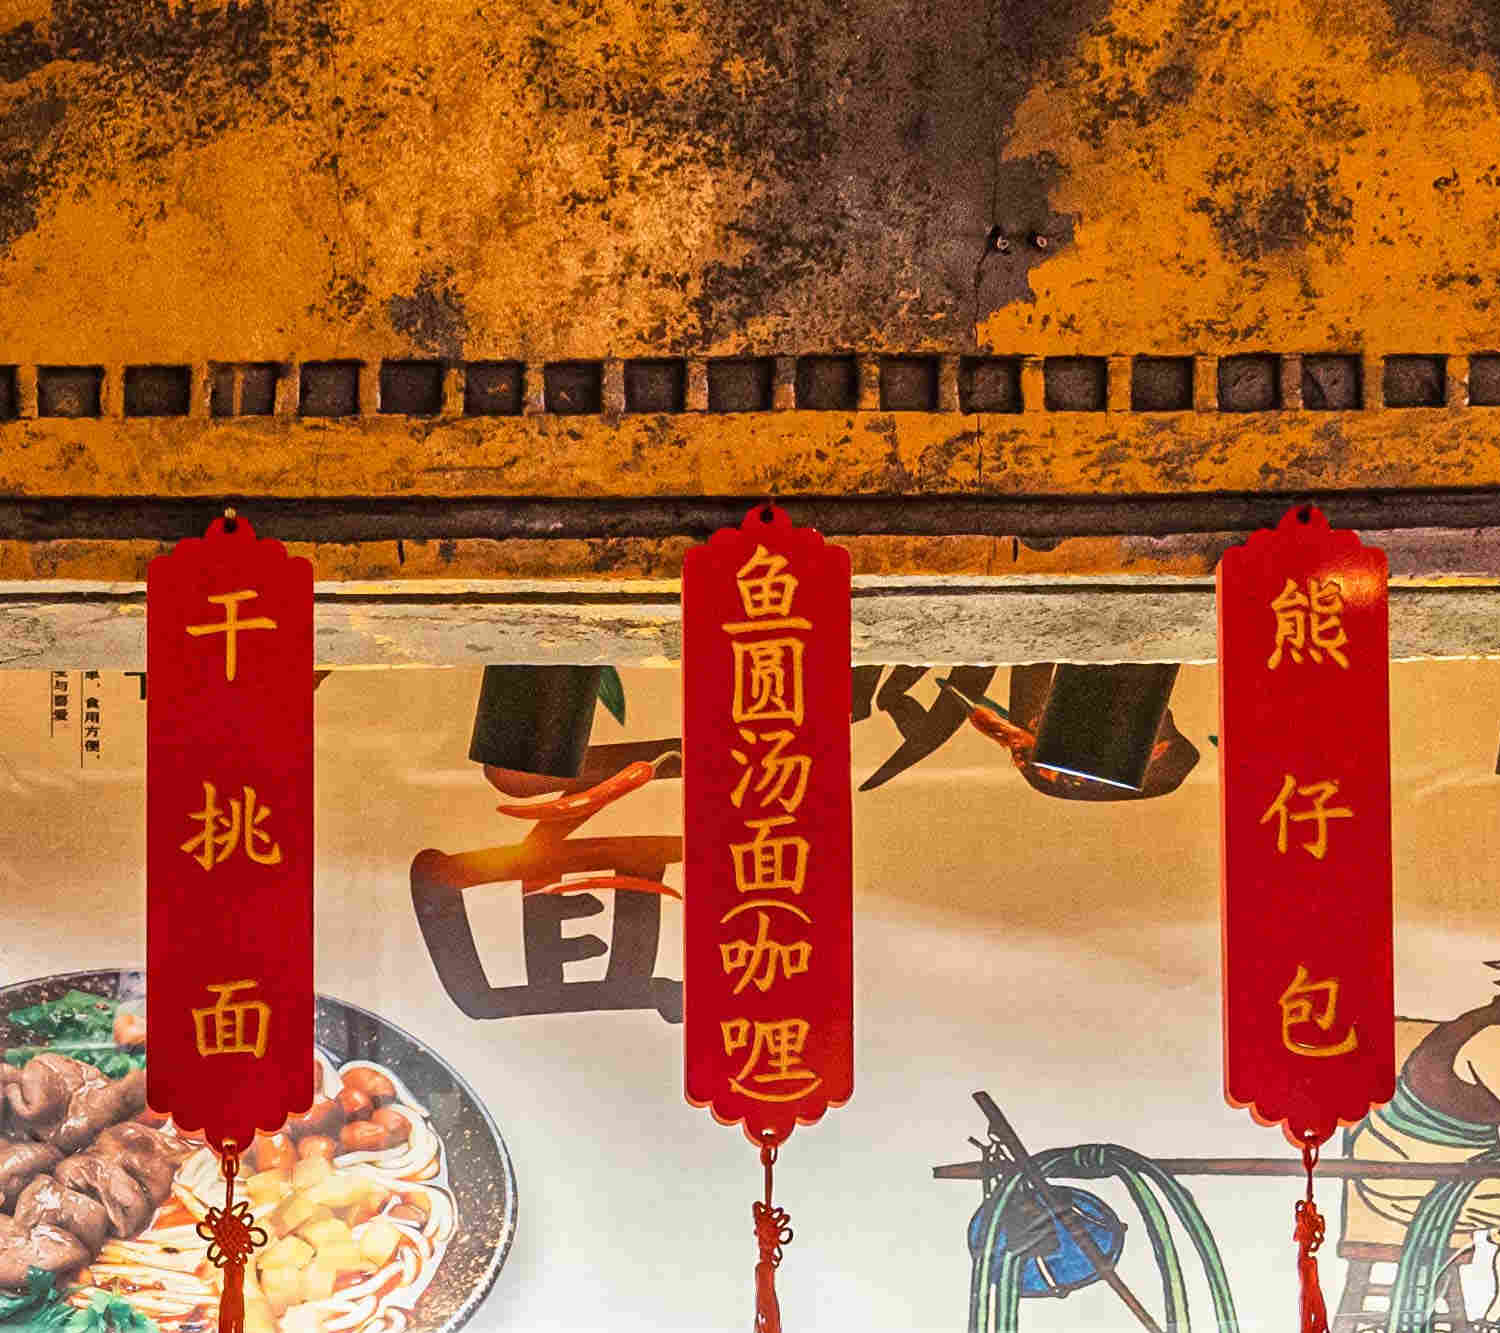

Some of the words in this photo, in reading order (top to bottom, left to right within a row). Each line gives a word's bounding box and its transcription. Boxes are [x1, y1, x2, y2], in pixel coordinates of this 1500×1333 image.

[180, 589, 282, 1059] 干挑面
[719, 543, 822, 1103] 鱼圆汤面（咖喱）
[1259, 577, 1359, 1058] 熊仔包
